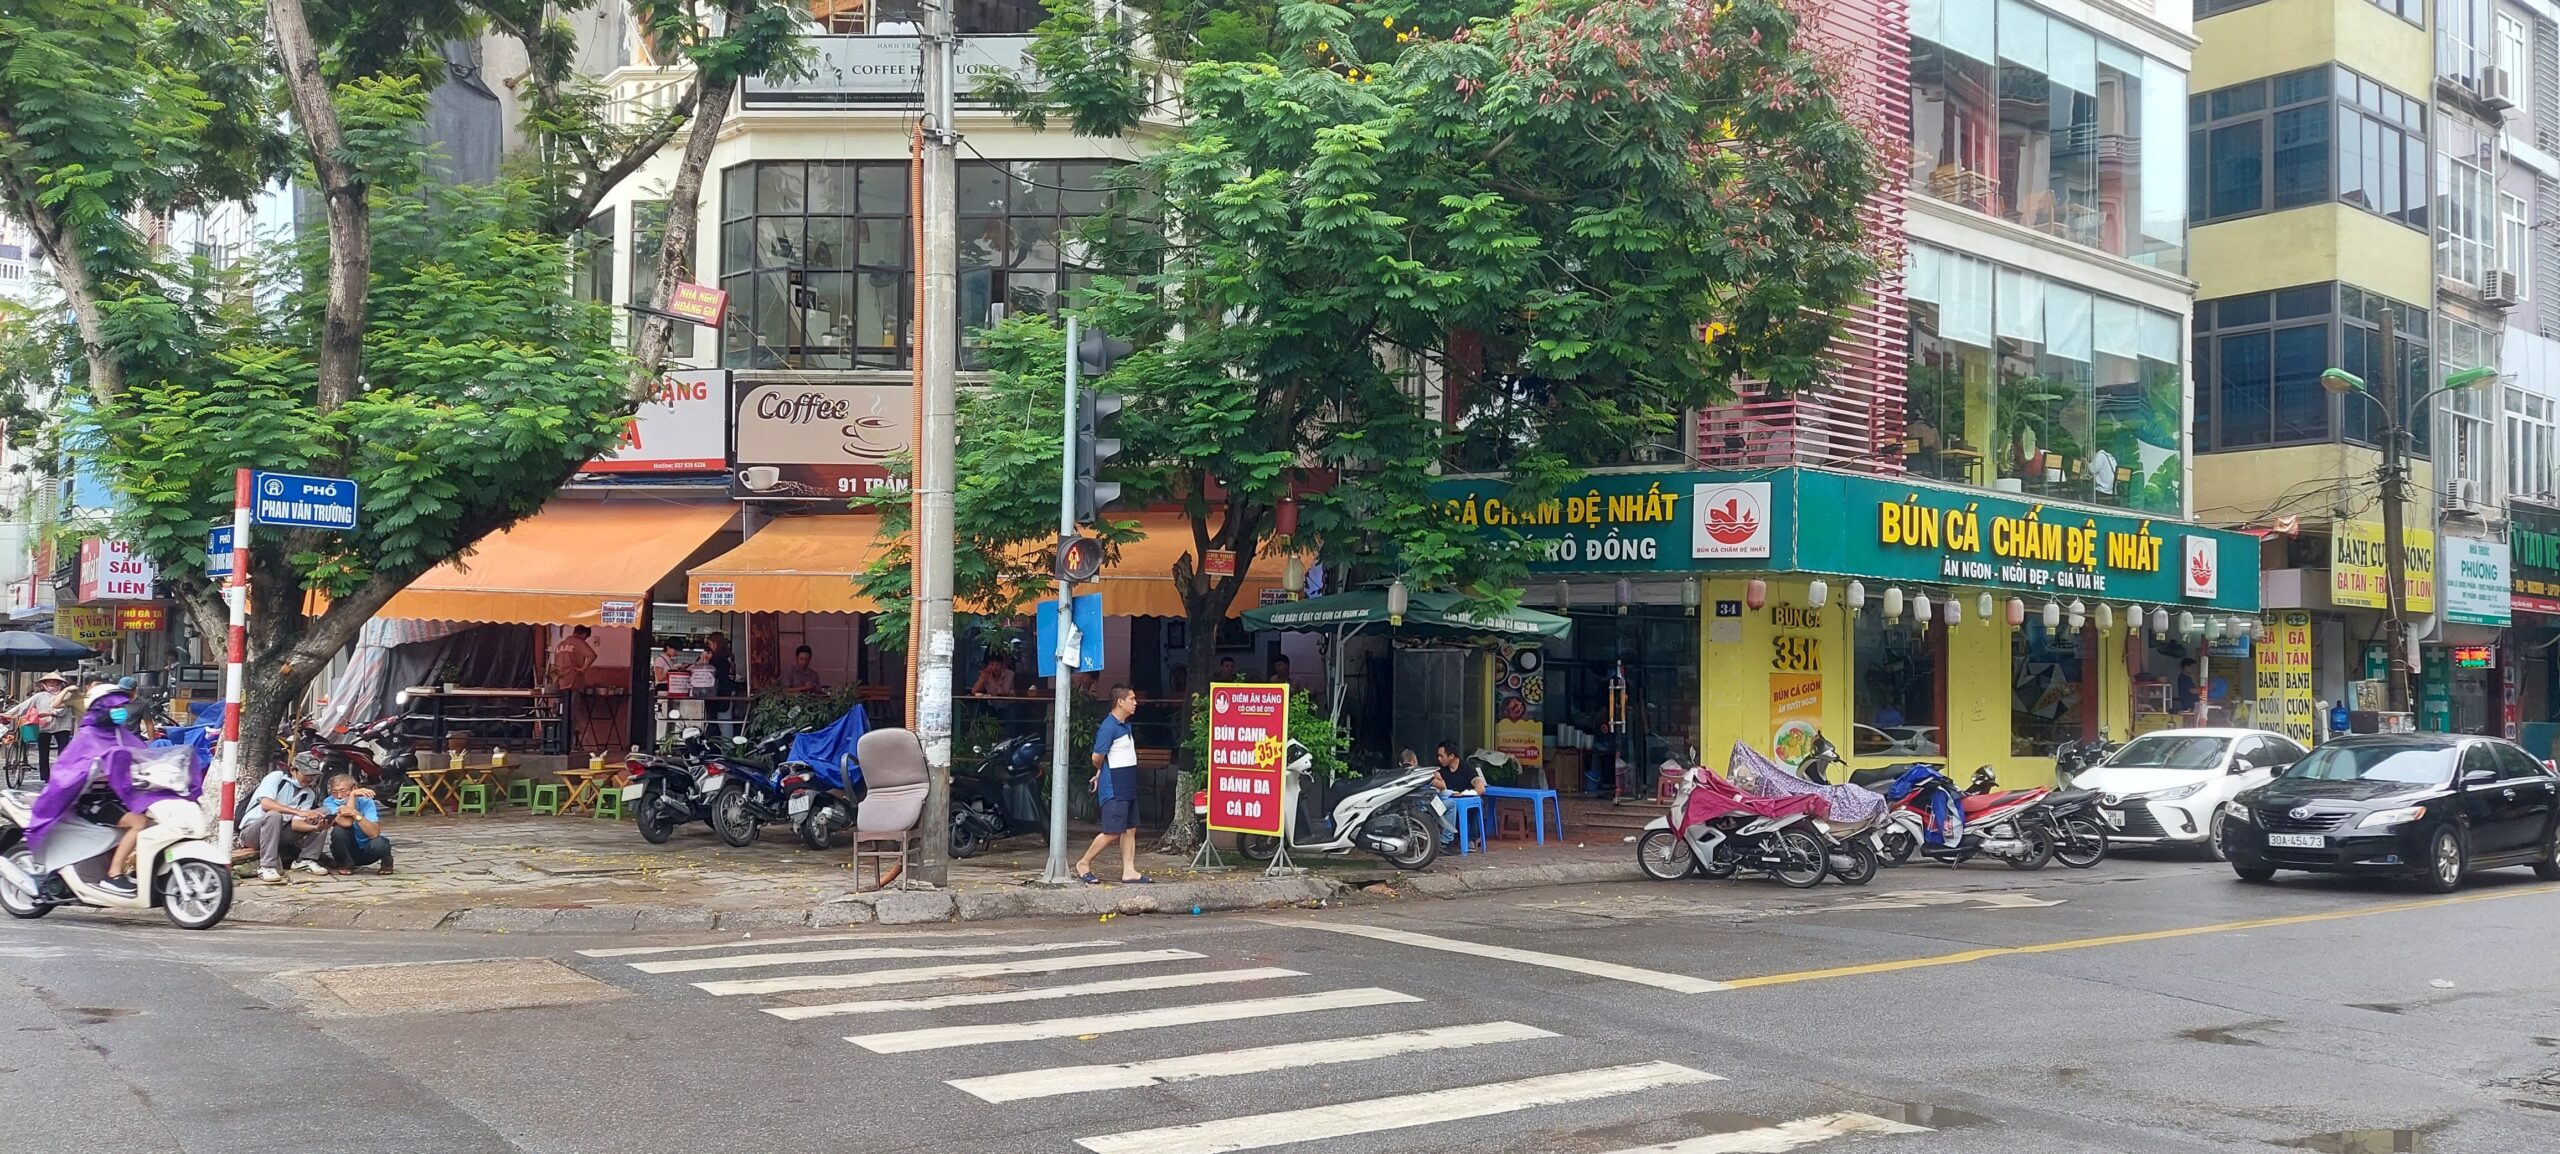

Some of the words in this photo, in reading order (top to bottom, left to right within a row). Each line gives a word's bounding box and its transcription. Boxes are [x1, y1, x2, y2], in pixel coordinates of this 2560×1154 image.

[852, 64, 906, 75] COFFEE
[674, 300, 702, 314] HOÀNG
[703, 307, 717, 317] GIA
[757, 391, 849, 424] Coffee
[303, 482, 337, 497] PHỐ
[838, 478, 857, 493] 91
[262, 499, 289, 519] PHAN
[291, 499, 311, 520] VĂN
[313, 502, 352, 523] TRƯỜNG
[1567, 489, 1601, 529] ĐỆ
[1608, 481, 1679, 523] NHẤT
[219, 529, 231, 545] PHỐ
[1881, 493, 1939, 548] BÚN
[1946, 503, 1980, 553] CÁ
[1992, 504, 2061, 562] CHẤM
[2067, 518, 2098, 573] ĐỆ
[2108, 520, 2163, 572] NHẤT
[1586, 527, 1656, 561] ĐỒNG
[2338, 532, 2368, 566] BÁNH
[1944, 554, 1959, 576] ĂN
[1962, 562, 1992, 581] NGON
[2002, 558, 2027, 584] NGỒI
[2029, 567, 2050, 590] ĐẸP
[2057, 566, 2074, 588] GIÁ
[2075, 569, 2091, 590] VỈA
[2093, 571, 2106, 591] HÈ
[2337, 568, 2348, 590] GÀ
[107, 581, 145, 595] LIÊN
[117, 605, 136, 618] PHỞ
[138, 605, 151, 618] GÀ
[152, 607, 163, 618] TA
[1720, 603, 1736, 615] 34
[1774, 602, 1800, 627] BÚN
[2288, 628, 2306, 645] GÀ
[1773, 635, 1821, 672] 35K
[2286, 647, 2309, 665] TẦN
[2259, 667, 2280, 688] BÁNH
[2286, 667, 2310, 689] BÁNH
[1232, 692, 1249, 703] ĐIỂM
[1250, 692, 1260, 704] ĂN
[1261, 694, 1281, 704] SÁNG
[1773, 687, 1789, 702] BÚN
[1790, 684, 1801, 698] CÁ
[1802, 679, 1821, 694] GIÒN
[2259, 690, 2280, 714] CUỐN
[2286, 691, 2310, 715] CUỐN
[1214, 724, 1235, 741] BÚN
[1238, 727, 1266, 742] CANH
[2286, 718, 2311, 740] NÓNG
[1213, 747, 1228, 764] CÁ
[1229, 748, 1256, 765] GIÒN
[1219, 775, 1250, 793] BÁNH
[1254, 779, 1270, 795] ĐA
[1226, 800, 1242, 816] CÁ
[1245, 800, 1261, 818] RÔ
